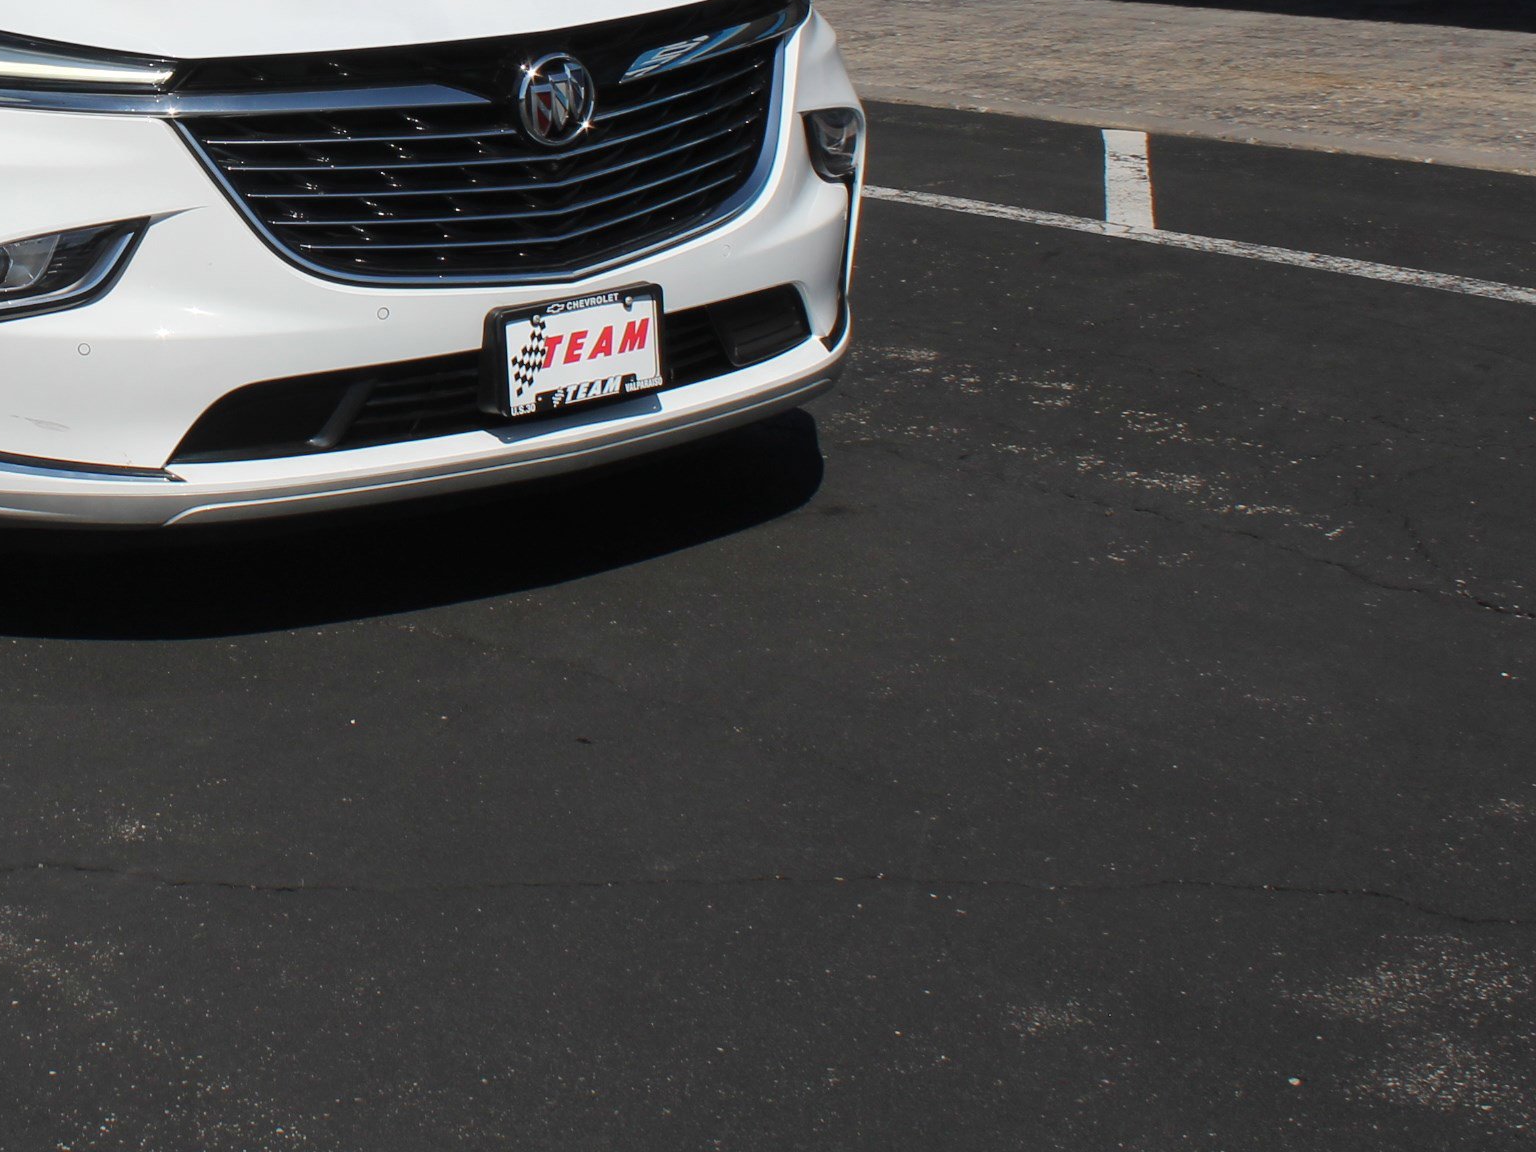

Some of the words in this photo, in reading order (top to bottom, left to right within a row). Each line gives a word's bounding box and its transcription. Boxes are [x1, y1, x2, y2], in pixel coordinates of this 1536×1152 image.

[566, 293, 620, 311] CHEVROLET
[542, 318, 650, 369] TEAM
[565, 376, 622, 404] TEAM
